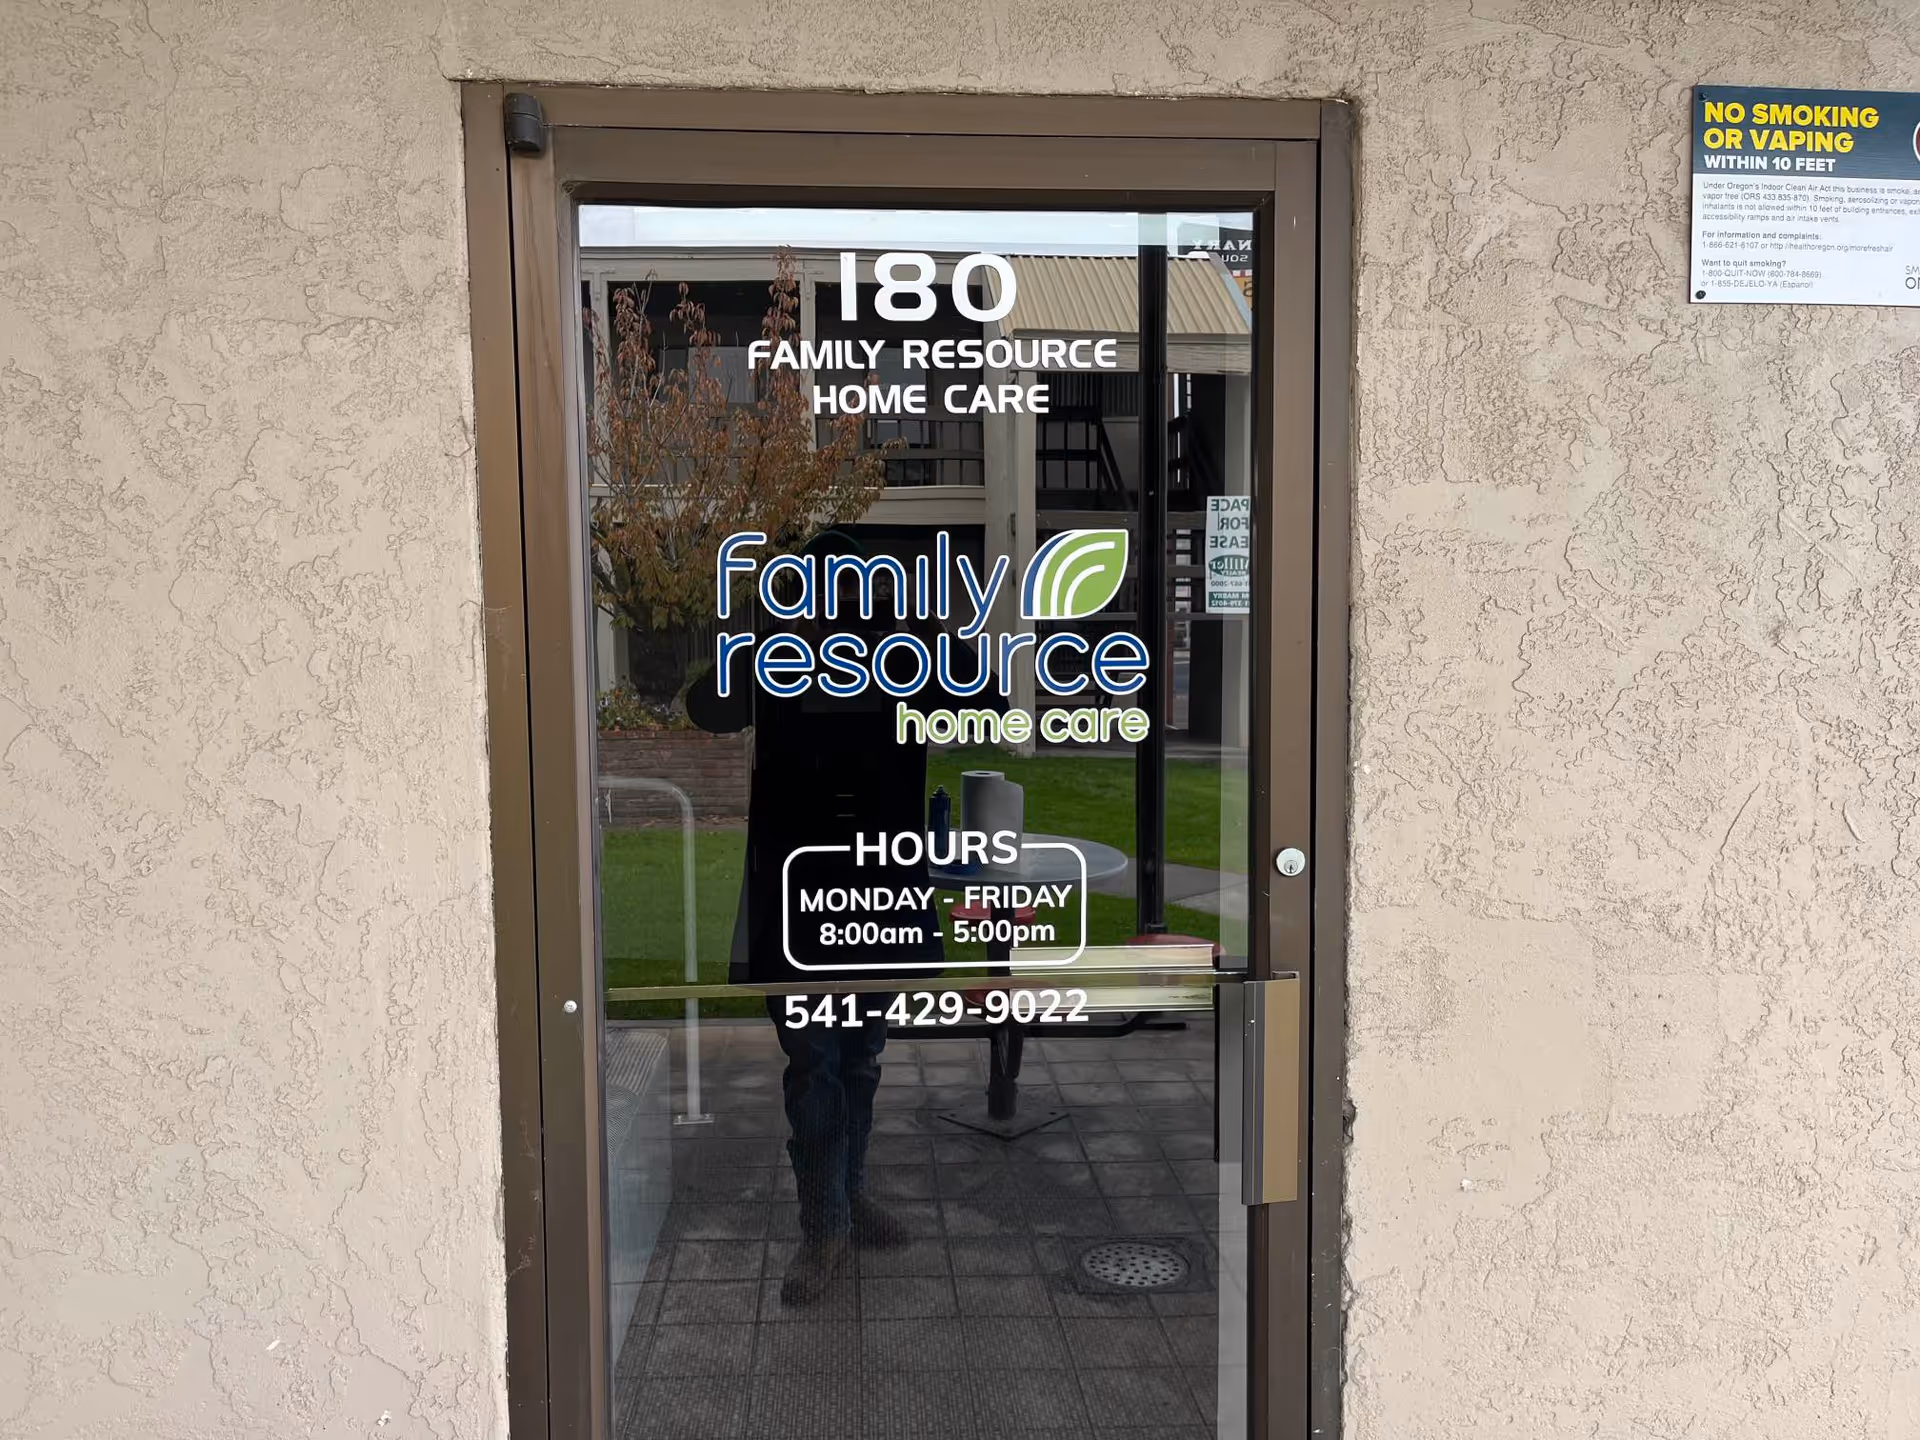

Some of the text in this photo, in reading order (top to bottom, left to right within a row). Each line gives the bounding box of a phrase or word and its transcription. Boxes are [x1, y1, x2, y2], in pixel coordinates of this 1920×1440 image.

[1704, 102, 1880, 129] NO SMOKING
[1703, 128, 1855, 153] OR VAPING
[1704, 155, 1836, 172] WITHIN 10 FEET
[1702, 193, 1724, 201] vapor
[1724, 192, 1739, 200] free
[1741, 192, 1761, 201] (ORS
[1847, 197, 1889, 206] aerosolizing
[1899, 198, 1920, 206] vapor
[1703, 182, 1725, 190] Under
[1726, 182, 1760, 192] Oregon's
[1761, 183, 1784, 191] Indoor
[1785, 183, 1807, 191] Clean
[1808, 184, 1818, 192] Air
[1820, 184, 1831, 193] Act
[1832, 185, 1845, 193] this
[1846, 186, 1878, 194] business
[1702, 213, 1745, 223] accessibility
[1746, 214, 1770, 223] ramps
[1771, 214, 1784, 222] and
[1819, 205, 1833, 213] feet
[1842, 206, 1870, 215] building
[1702, 230, 1715, 238] For
[1717, 231, 1761, 239] information
[1778, 232, 1822, 241] complaints:
[1701, 259, 1786, 269] Want to quit smoking?
[1702, 269, 1766, 277] 1-800-QUIT-NOW
[839, 251, 1017, 322] 180
[1711, 279, 1778, 288] 1-855-DEJELO-YA
[747, 338, 1118, 369] FAMILY RESOURCE
[813, 384, 1050, 415] HOME CARE
[717, 531, 1009, 636] family
[717, 631, 1149, 697] resource
[896, 703, 1149, 744] home care
[855, 830, 1019, 867] HOURS
[800, 887, 936, 913] MONDAY
[964, 885, 1073, 910] FRIDAY
[819, 922, 923, 946] 8:00am
[953, 920, 1056, 949] 5:00pm
[784, 988, 1090, 1029] 541-429-9022
